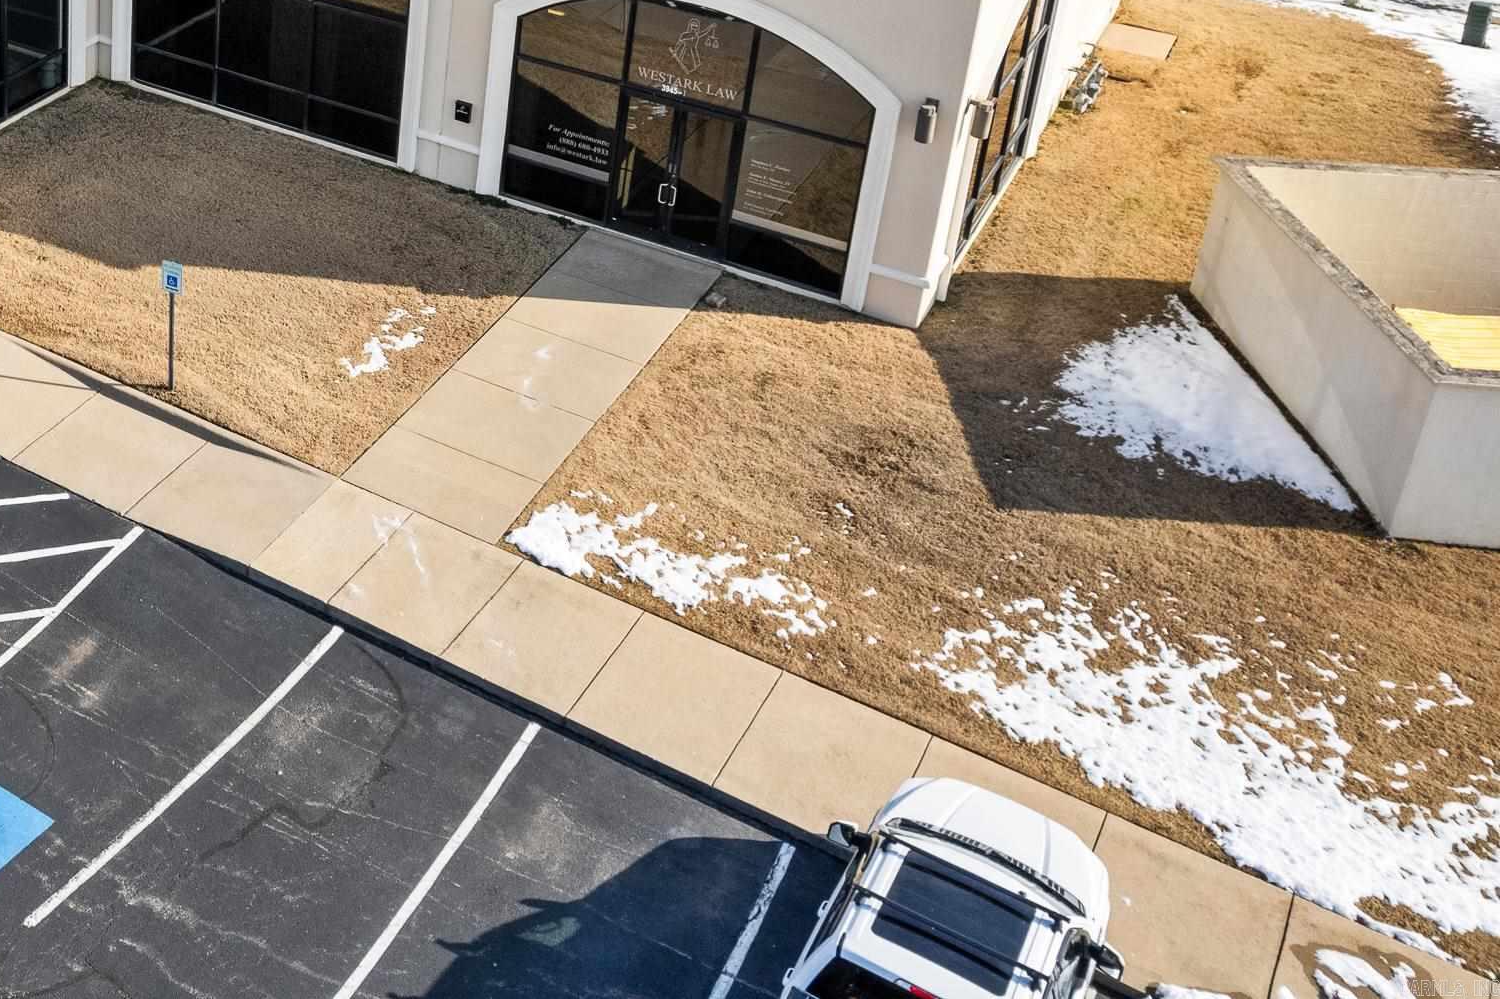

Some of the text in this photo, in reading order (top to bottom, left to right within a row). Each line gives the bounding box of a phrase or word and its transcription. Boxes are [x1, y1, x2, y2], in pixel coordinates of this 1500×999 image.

[638, 66, 739, 101] WESTARK LAW
[548, 123, 562, 133] For
